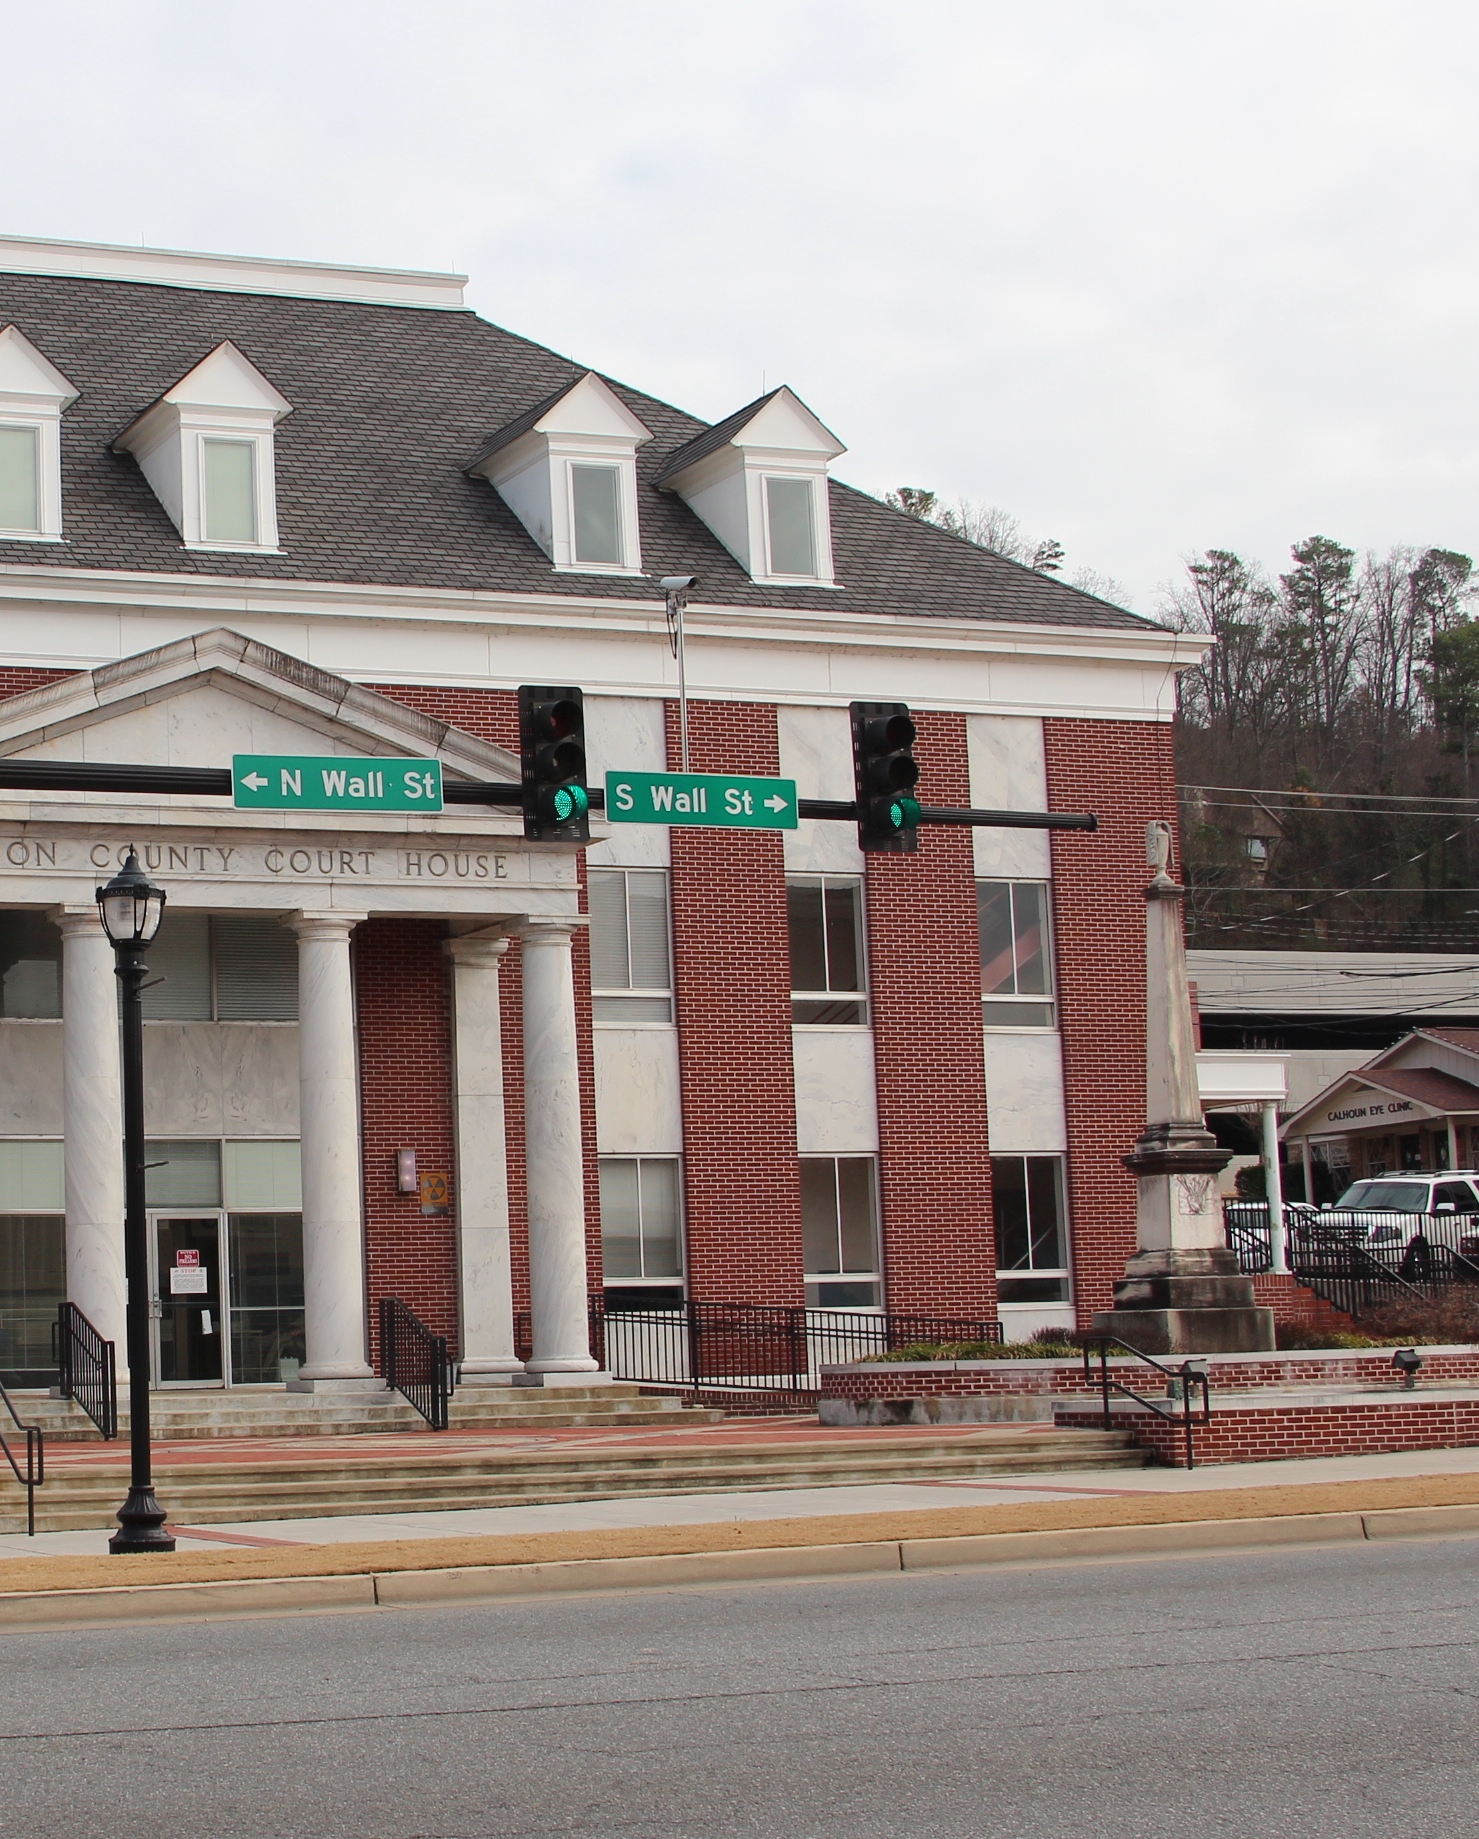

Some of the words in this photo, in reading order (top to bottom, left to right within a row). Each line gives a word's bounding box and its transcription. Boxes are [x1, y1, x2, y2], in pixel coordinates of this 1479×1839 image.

[280, 769, 302, 796] N
[321, 770, 383, 798] Wall
[403, 771, 435, 799] St
[615, 783, 634, 811] S
[650, 785, 707, 813] Wall
[724, 788, 753, 816] St
[264, 849, 375, 875] COURT
[405, 852, 508, 879] HOUSE
[1327, 1108, 1366, 1121] CALHOUN
[1369, 1105, 1384, 1115] EYE
[1387, 1101, 1413, 1113] CLINIC
